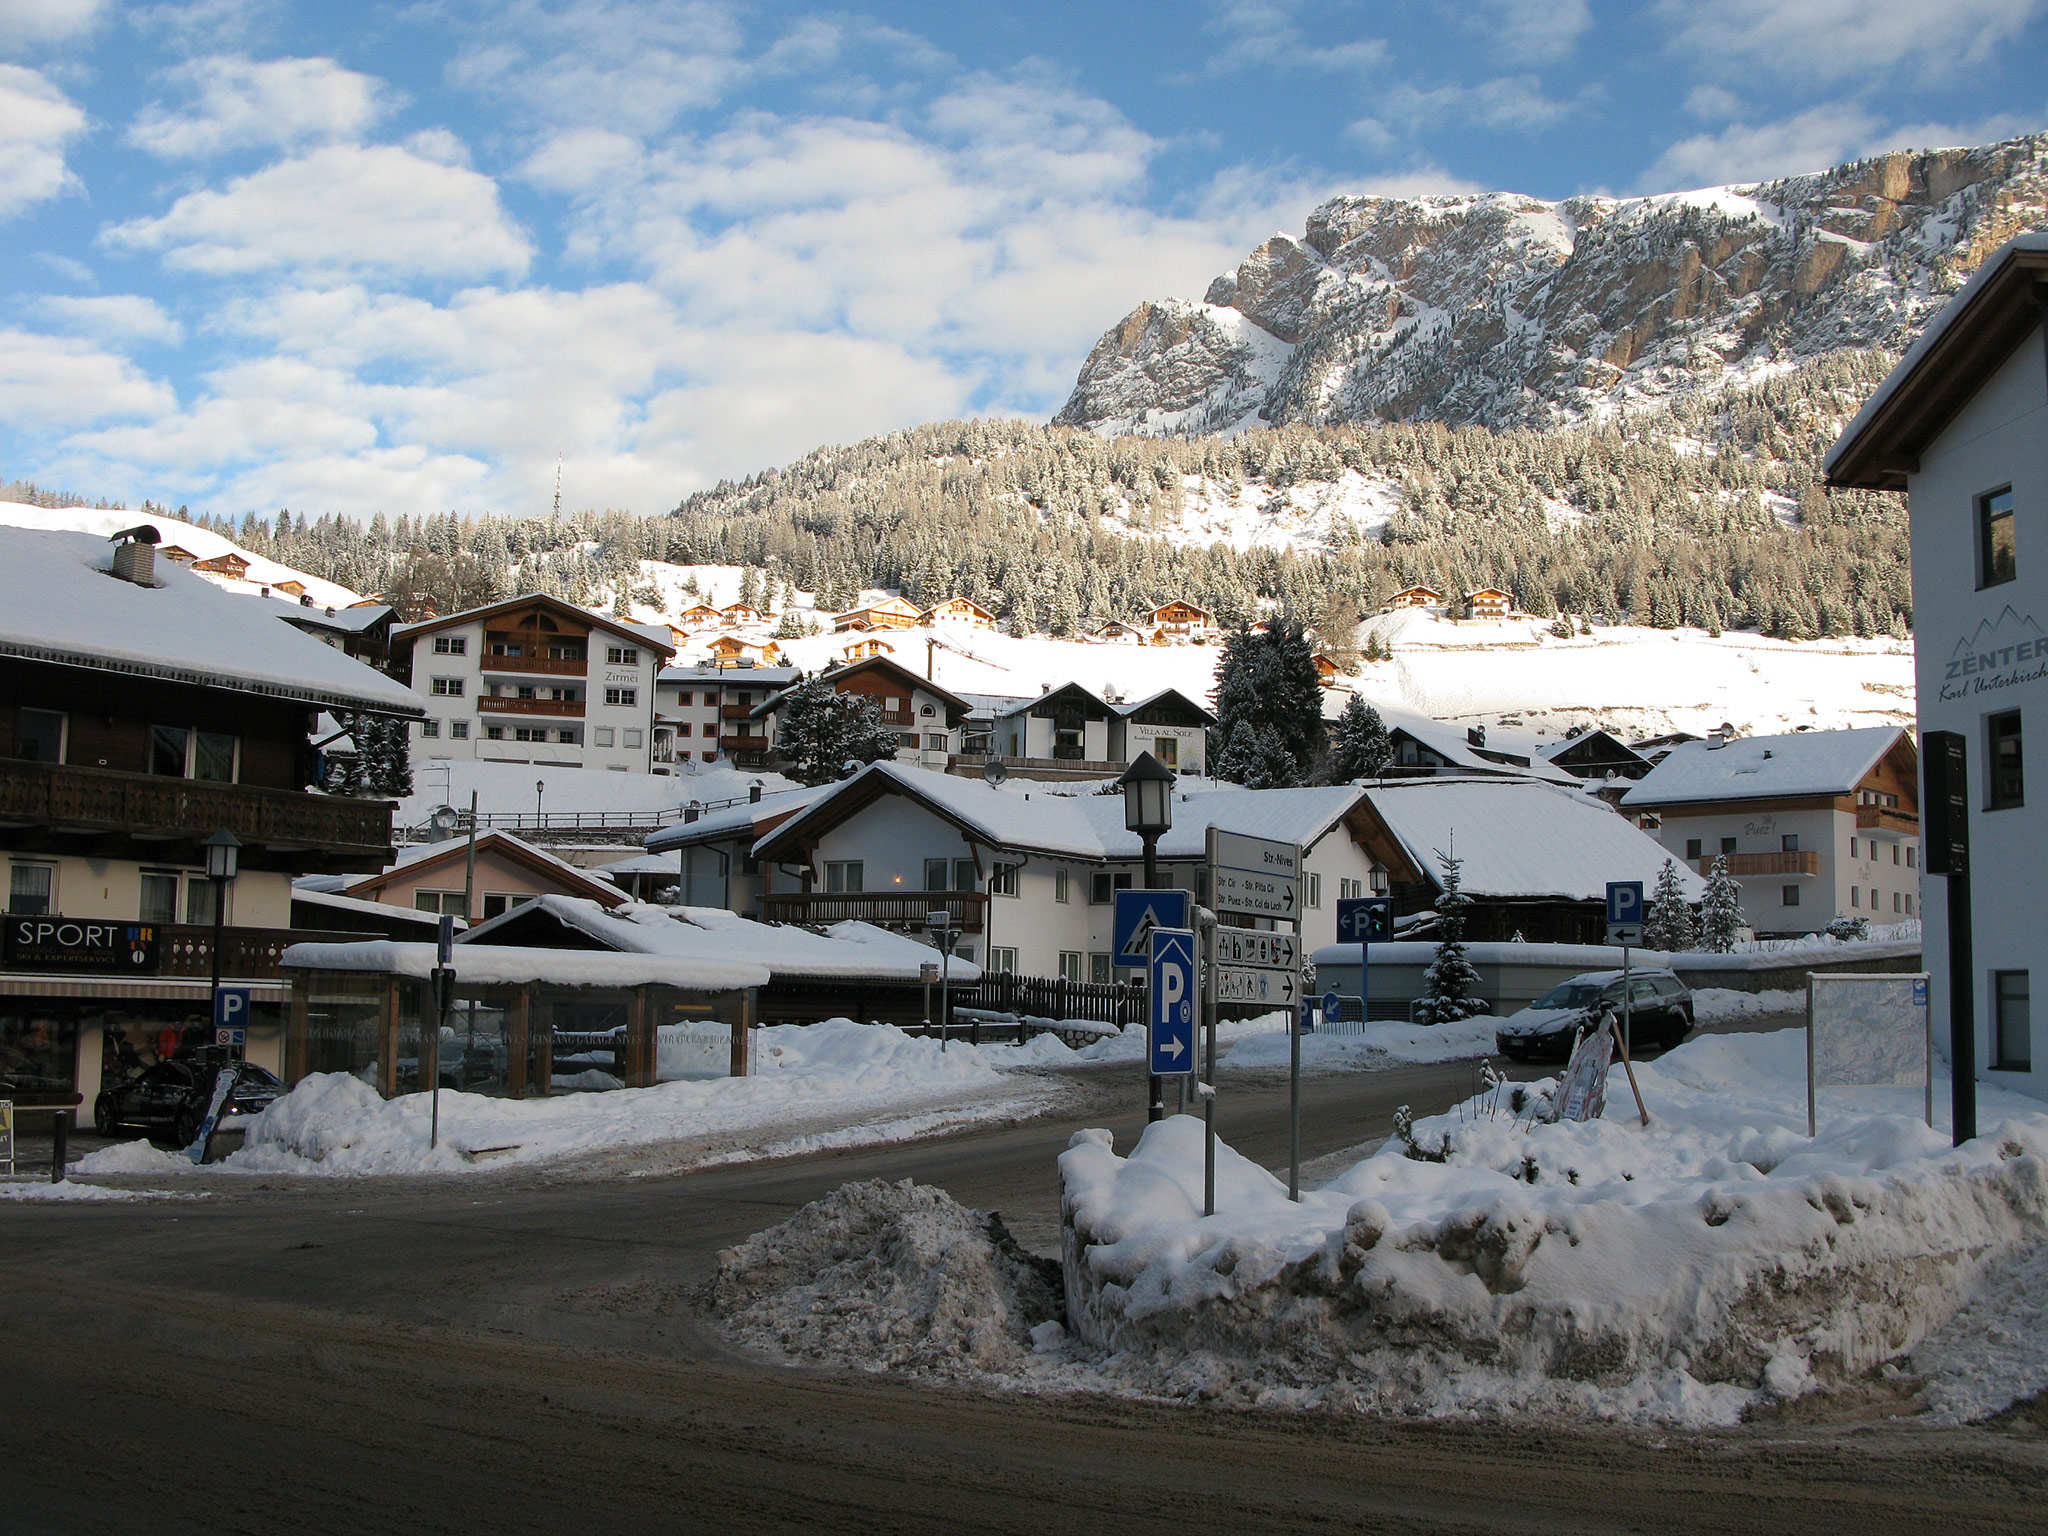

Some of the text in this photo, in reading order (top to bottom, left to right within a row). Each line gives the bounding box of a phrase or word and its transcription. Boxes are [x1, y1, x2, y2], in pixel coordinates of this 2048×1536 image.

[1939, 681, 1969, 702] Karl
[1245, 880, 1254, 891] Str.
[1245, 897, 1254, 907] Str.
[1614, 887, 1636, 920] P
[18, 922, 118, 947] SPORT
[1354, 912, 1370, 937] P
[16, 953, 31, 961] SKI
[1162, 962, 1184, 1023] P
[224, 994, 243, 1022] P
